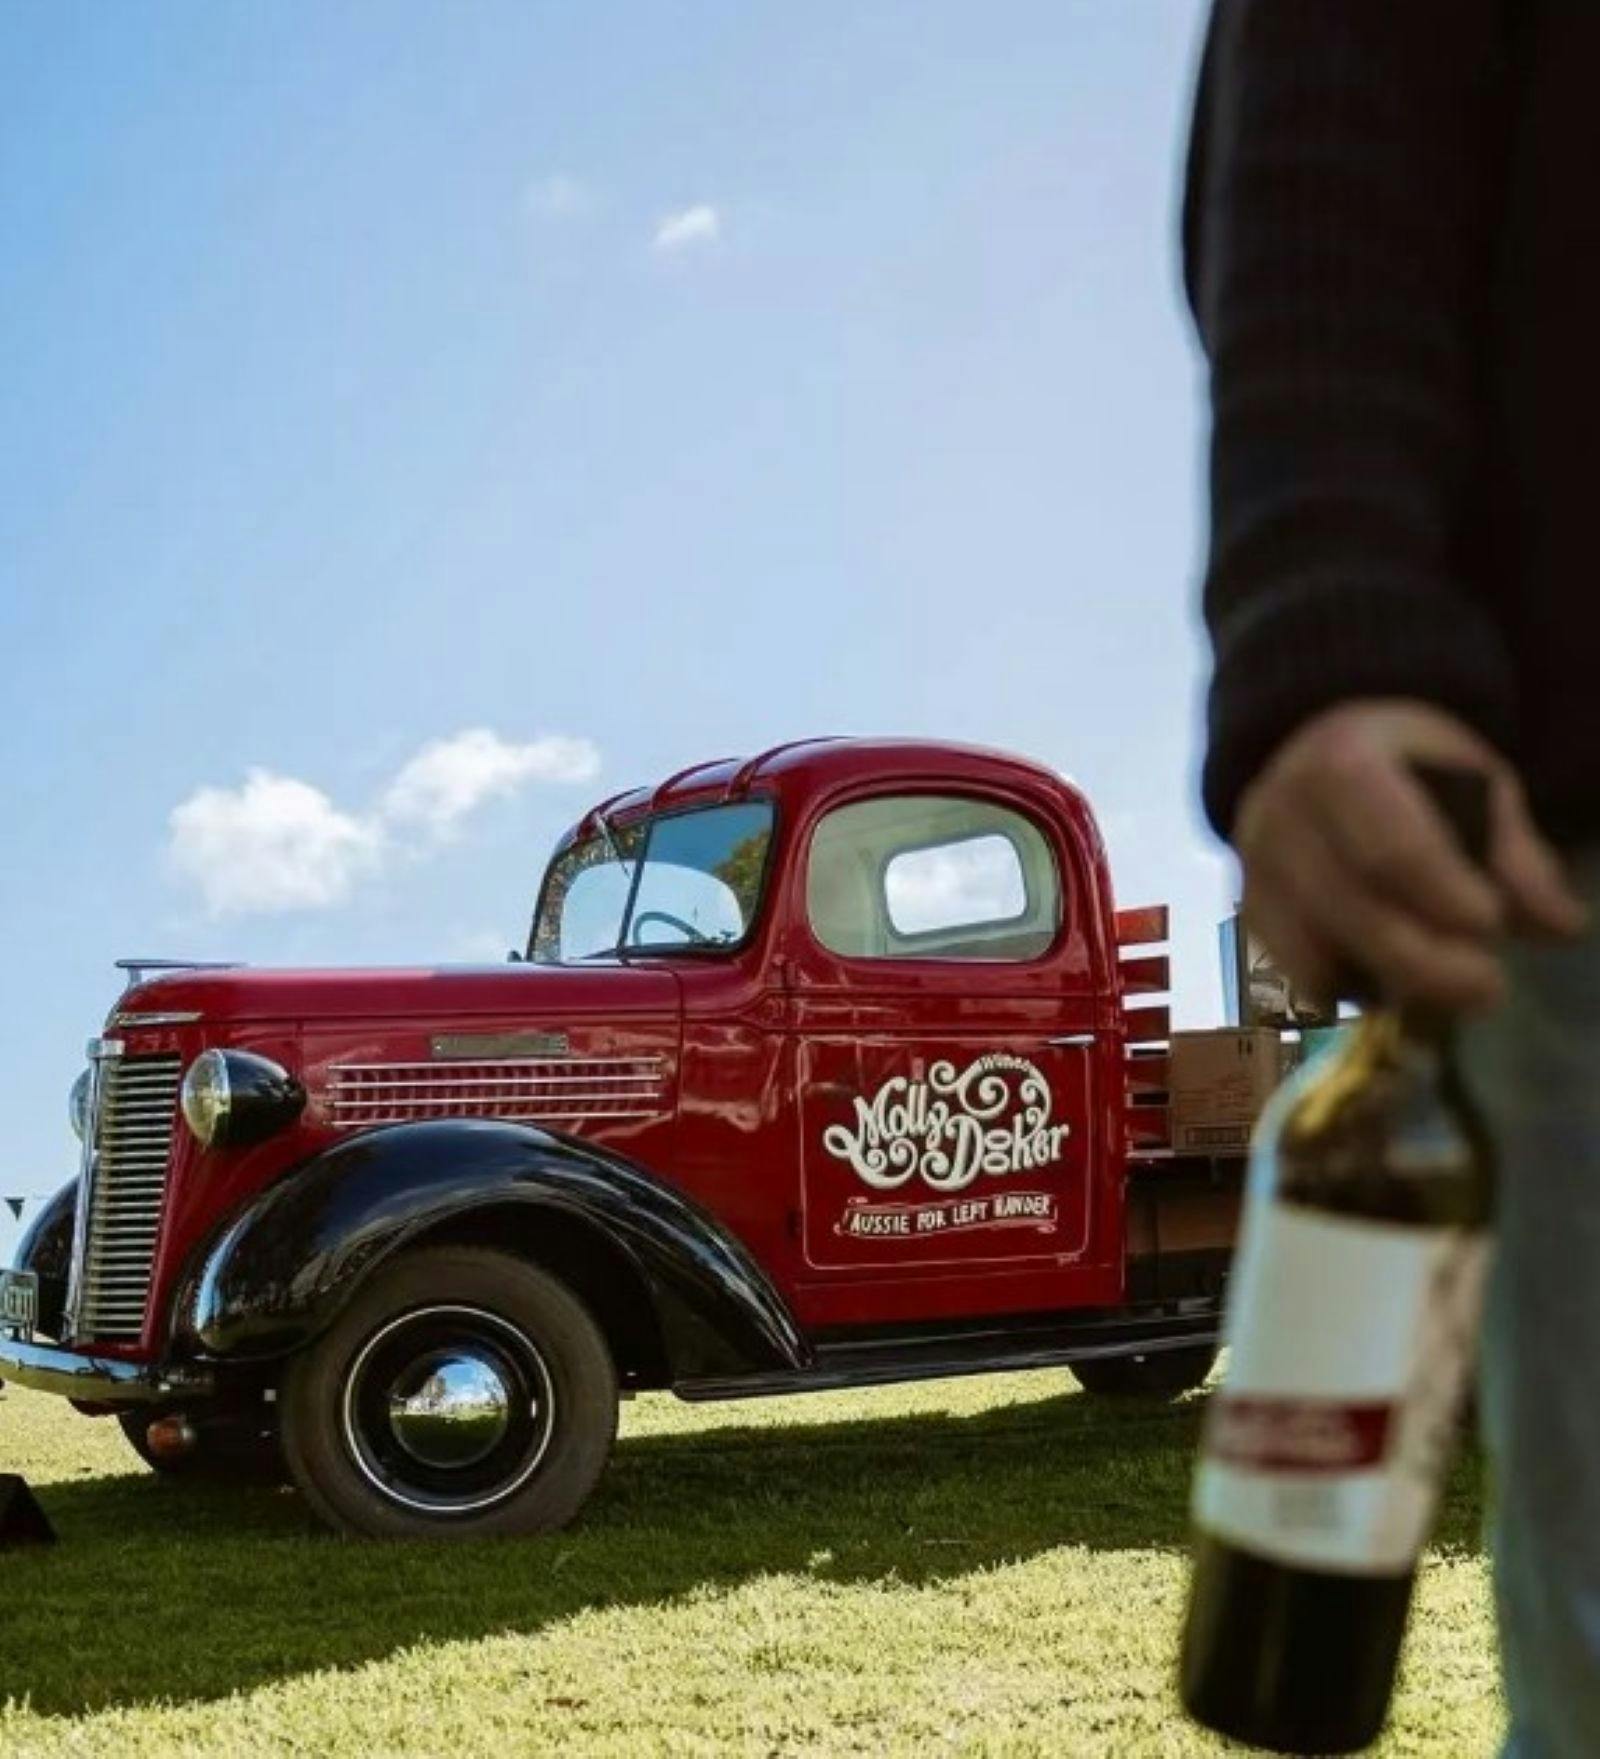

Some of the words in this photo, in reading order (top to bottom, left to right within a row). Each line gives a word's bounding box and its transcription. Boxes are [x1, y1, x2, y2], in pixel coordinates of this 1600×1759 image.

[850, 1212, 910, 1234] AUSSIE
[917, 1210, 947, 1231] FOR
[953, 1202, 989, 1224] LEFT
